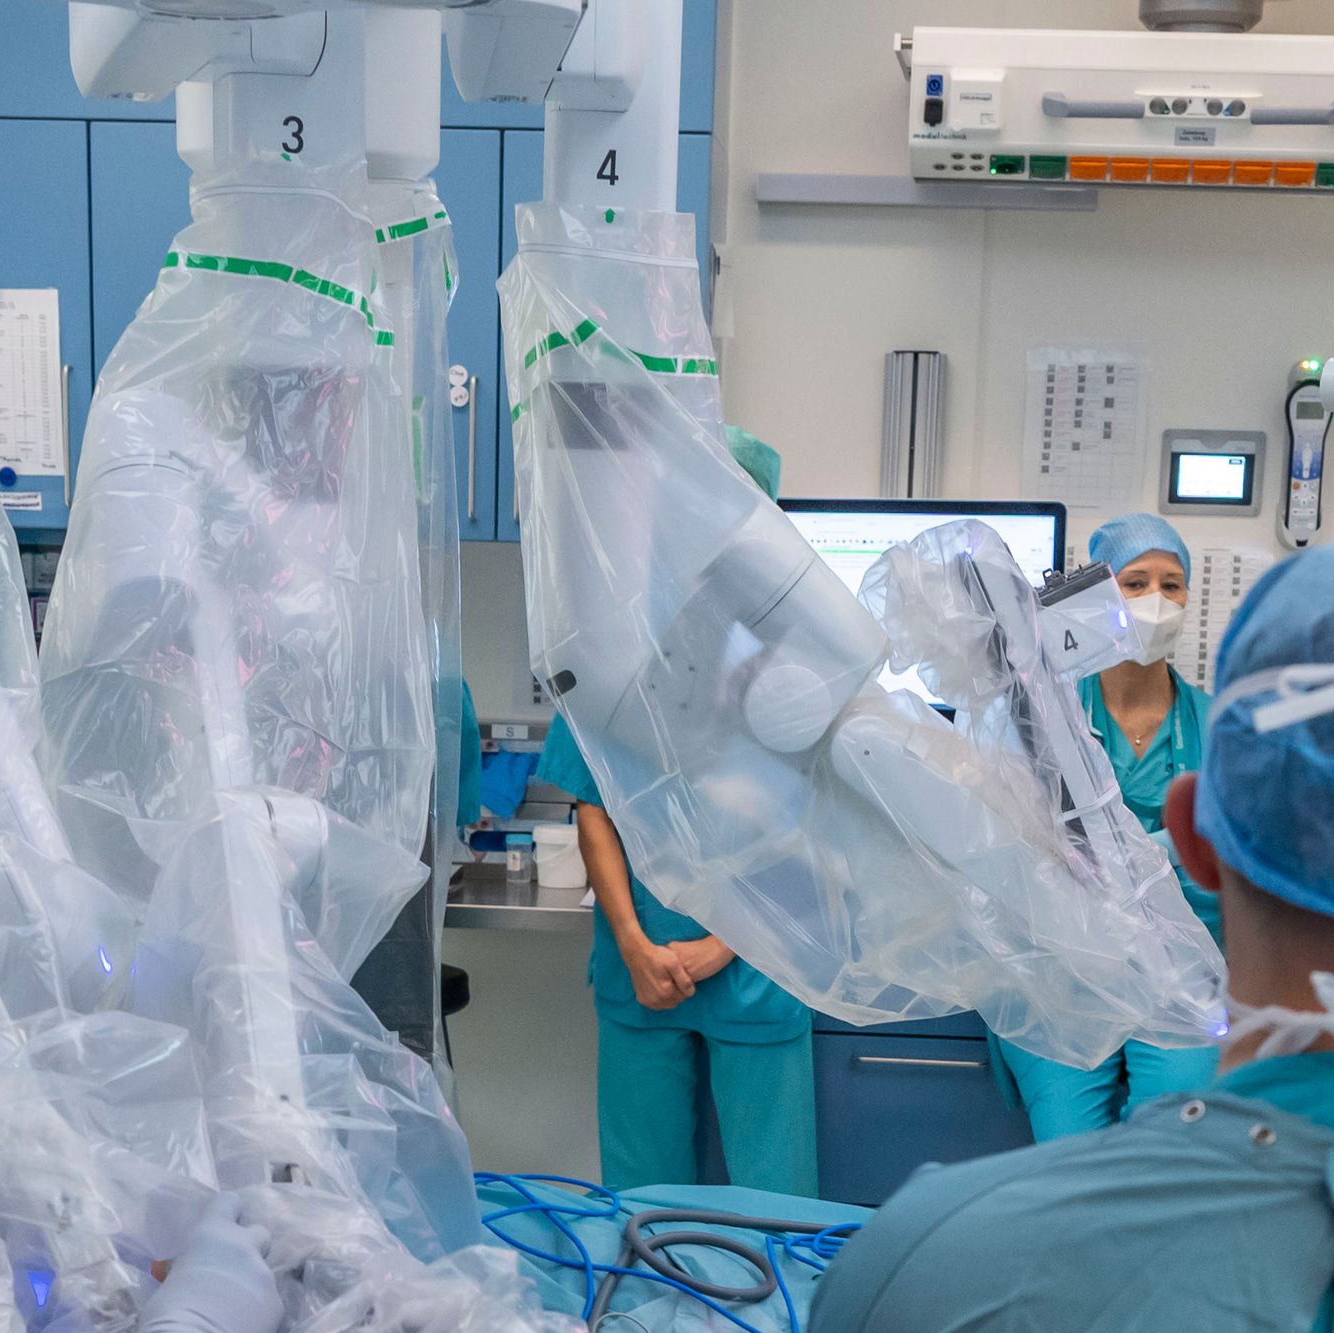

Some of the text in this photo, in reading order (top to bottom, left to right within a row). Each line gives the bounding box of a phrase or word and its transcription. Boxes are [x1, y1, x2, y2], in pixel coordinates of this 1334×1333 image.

[281, 115, 305, 155] 3
[596, 149, 619, 187] 4
[1063, 629, 1078, 652] 4
[506, 727, 514, 737] S
